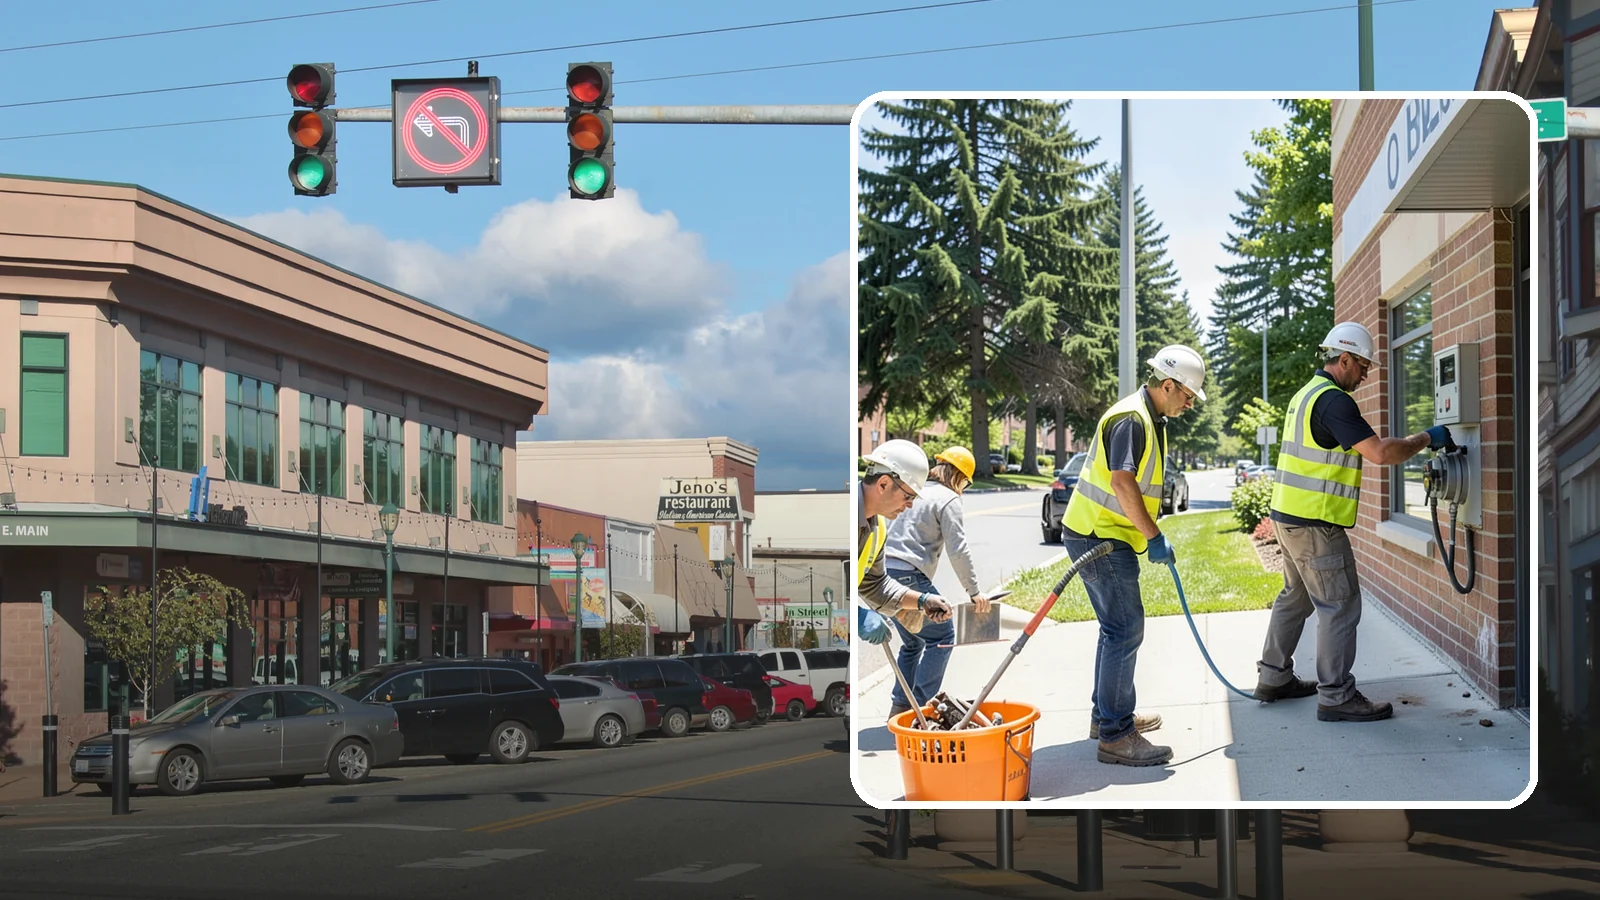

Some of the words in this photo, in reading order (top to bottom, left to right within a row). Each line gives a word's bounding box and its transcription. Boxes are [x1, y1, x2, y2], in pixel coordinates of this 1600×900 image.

[669, 480, 728, 494] Jeno's
[665, 496, 731, 509] restaurant
[658, 510, 681, 519] Italian
[686, 509, 715, 519] American
[715, 509, 737, 519] Cuisine
[2, 525, 13, 536] E.
[15, 525, 49, 536] MAIN
[786, 608, 795, 617] in
[797, 607, 829, 617] Street
